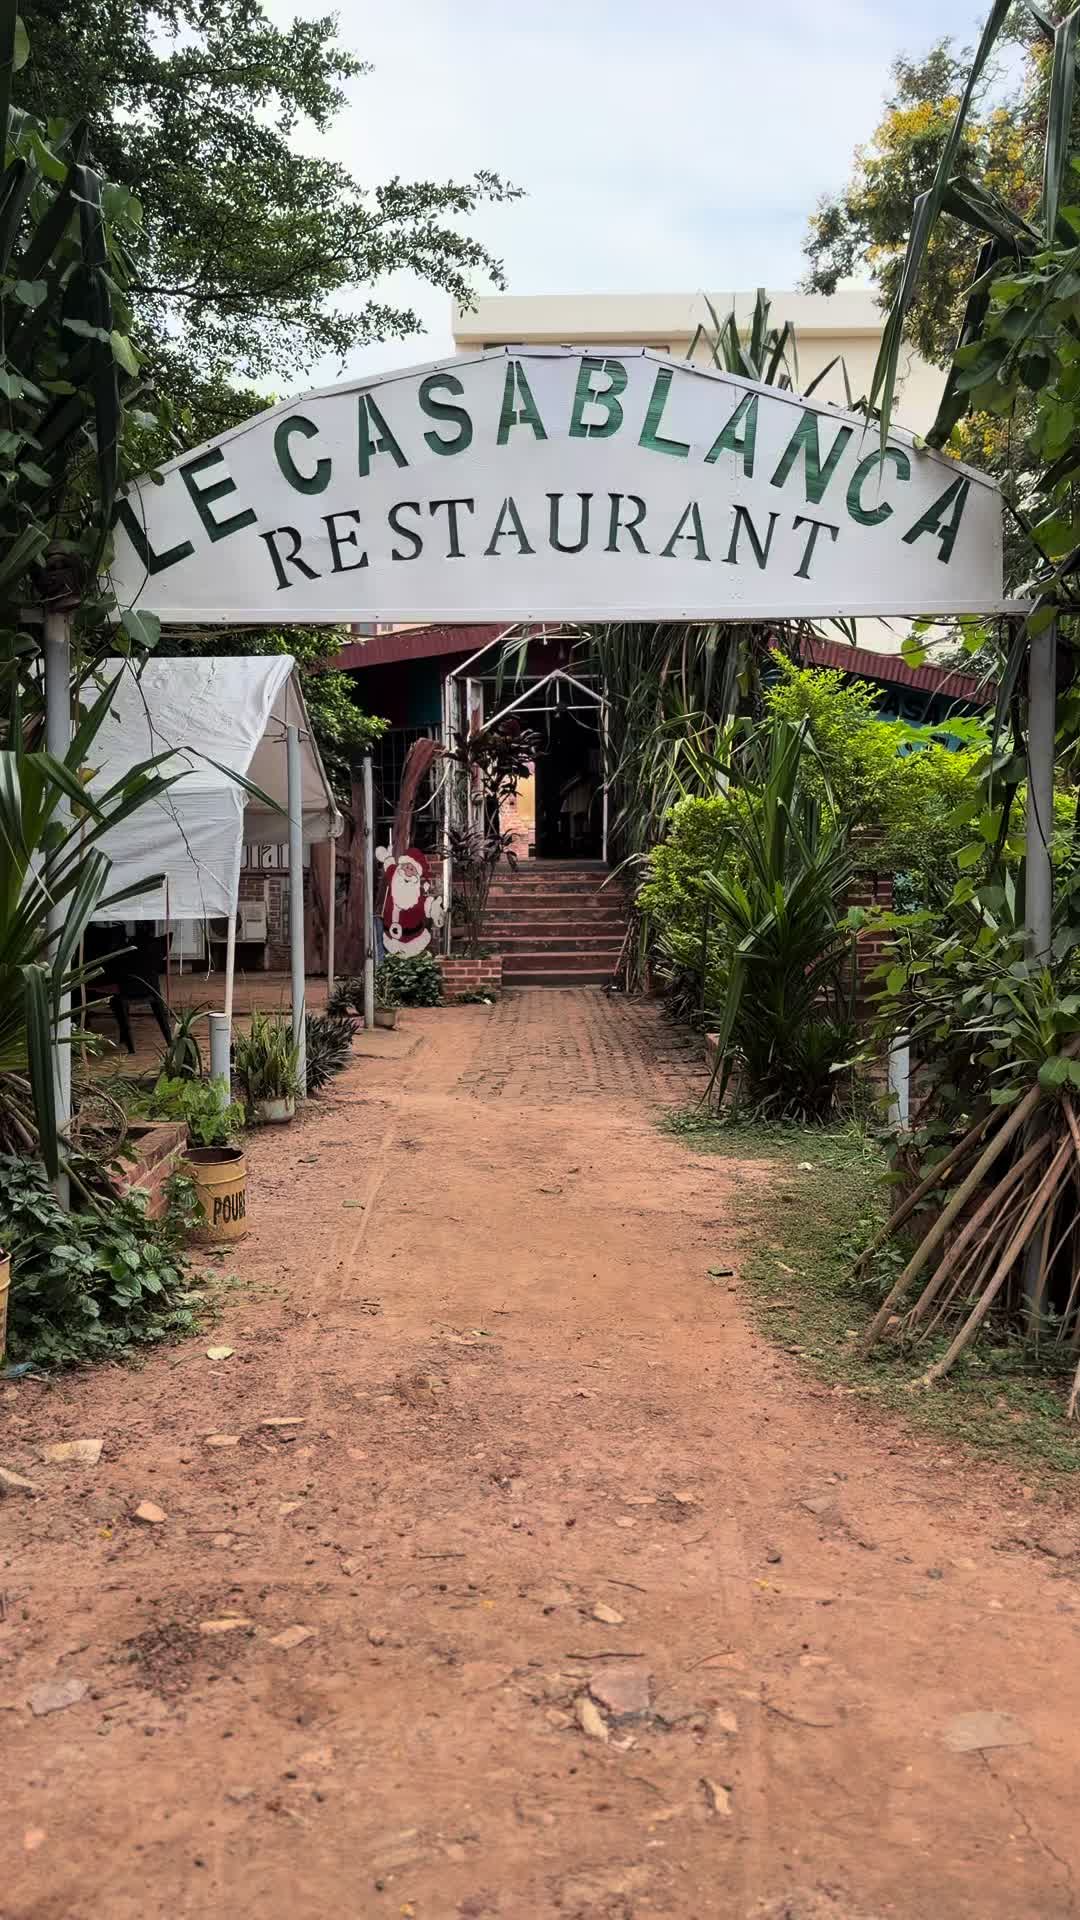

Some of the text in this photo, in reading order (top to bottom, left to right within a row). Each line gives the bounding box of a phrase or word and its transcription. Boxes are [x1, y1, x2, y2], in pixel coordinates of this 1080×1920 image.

[112, 357, 971, 576] LE CASABLANCA
[259, 492, 840, 590] RESTAURANT
